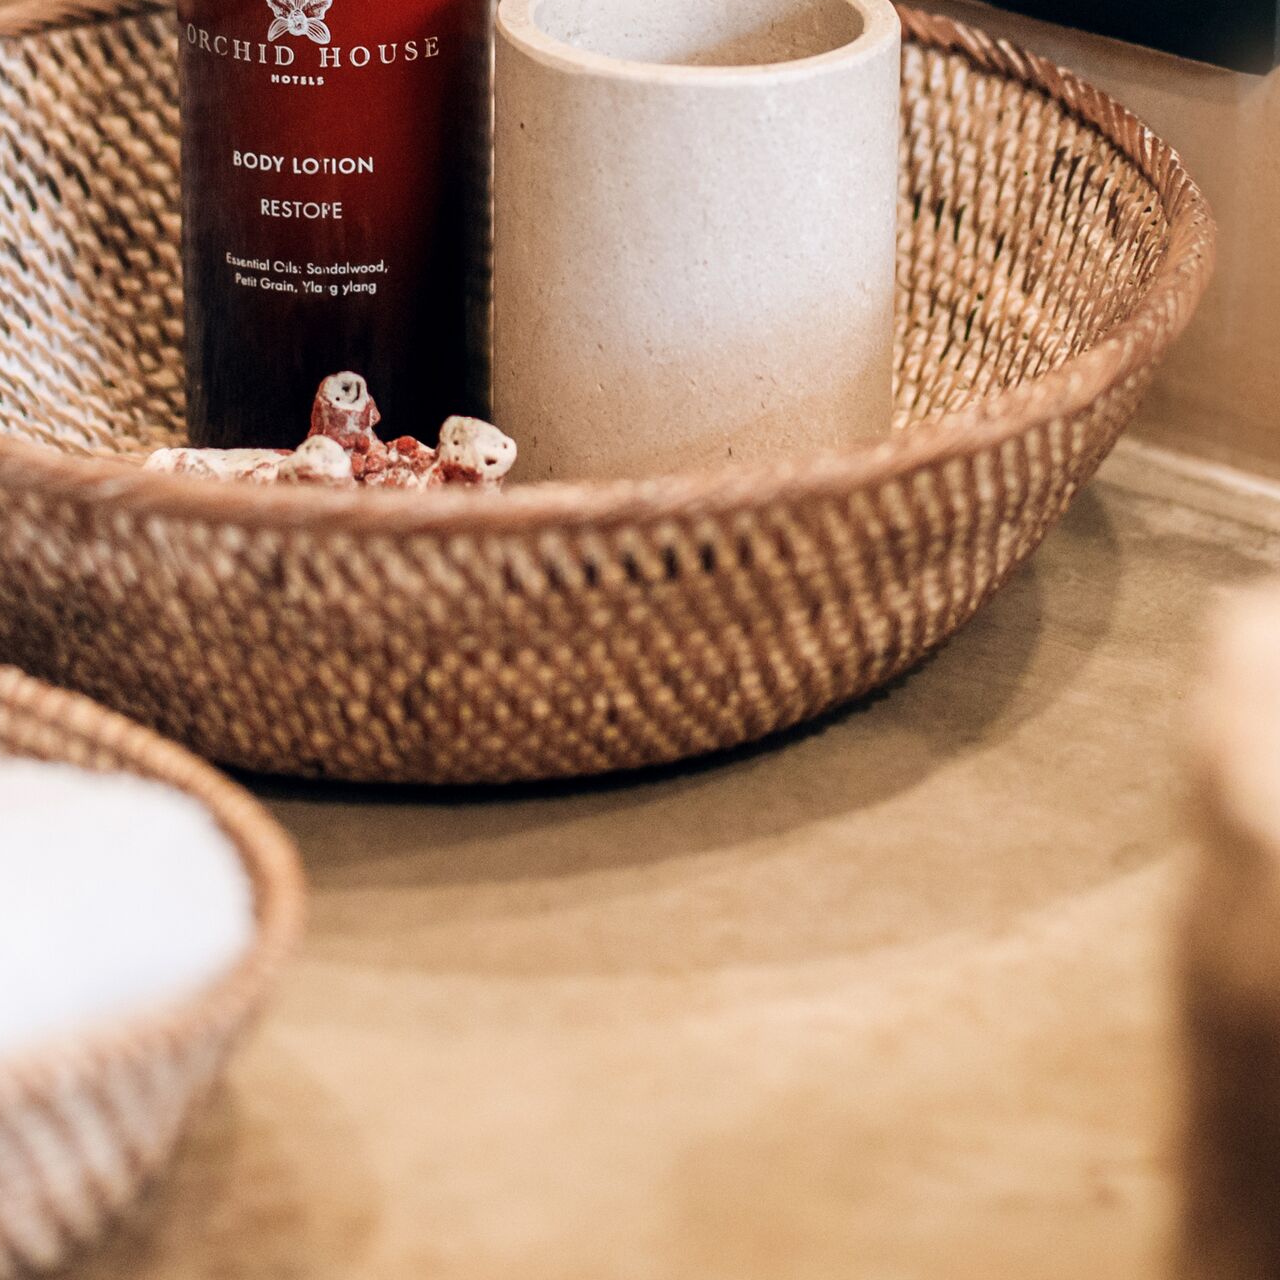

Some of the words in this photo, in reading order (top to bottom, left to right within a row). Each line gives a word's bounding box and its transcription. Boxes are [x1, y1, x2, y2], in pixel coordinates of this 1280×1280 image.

[186, 23, 295, 66] ORCHID
[319, 36, 439, 68] HOUSE
[271, 74, 325, 86] HOTELS
[233, 150, 285, 173] BODY
[292, 156, 374, 175] LOTION
[260, 198, 343, 220] RESTORE
[225, 252, 270, 271] Essential
[235, 272, 257, 287] Petit
[302, 280, 338, 296] Ylag
[342, 280, 377, 296] ylang
